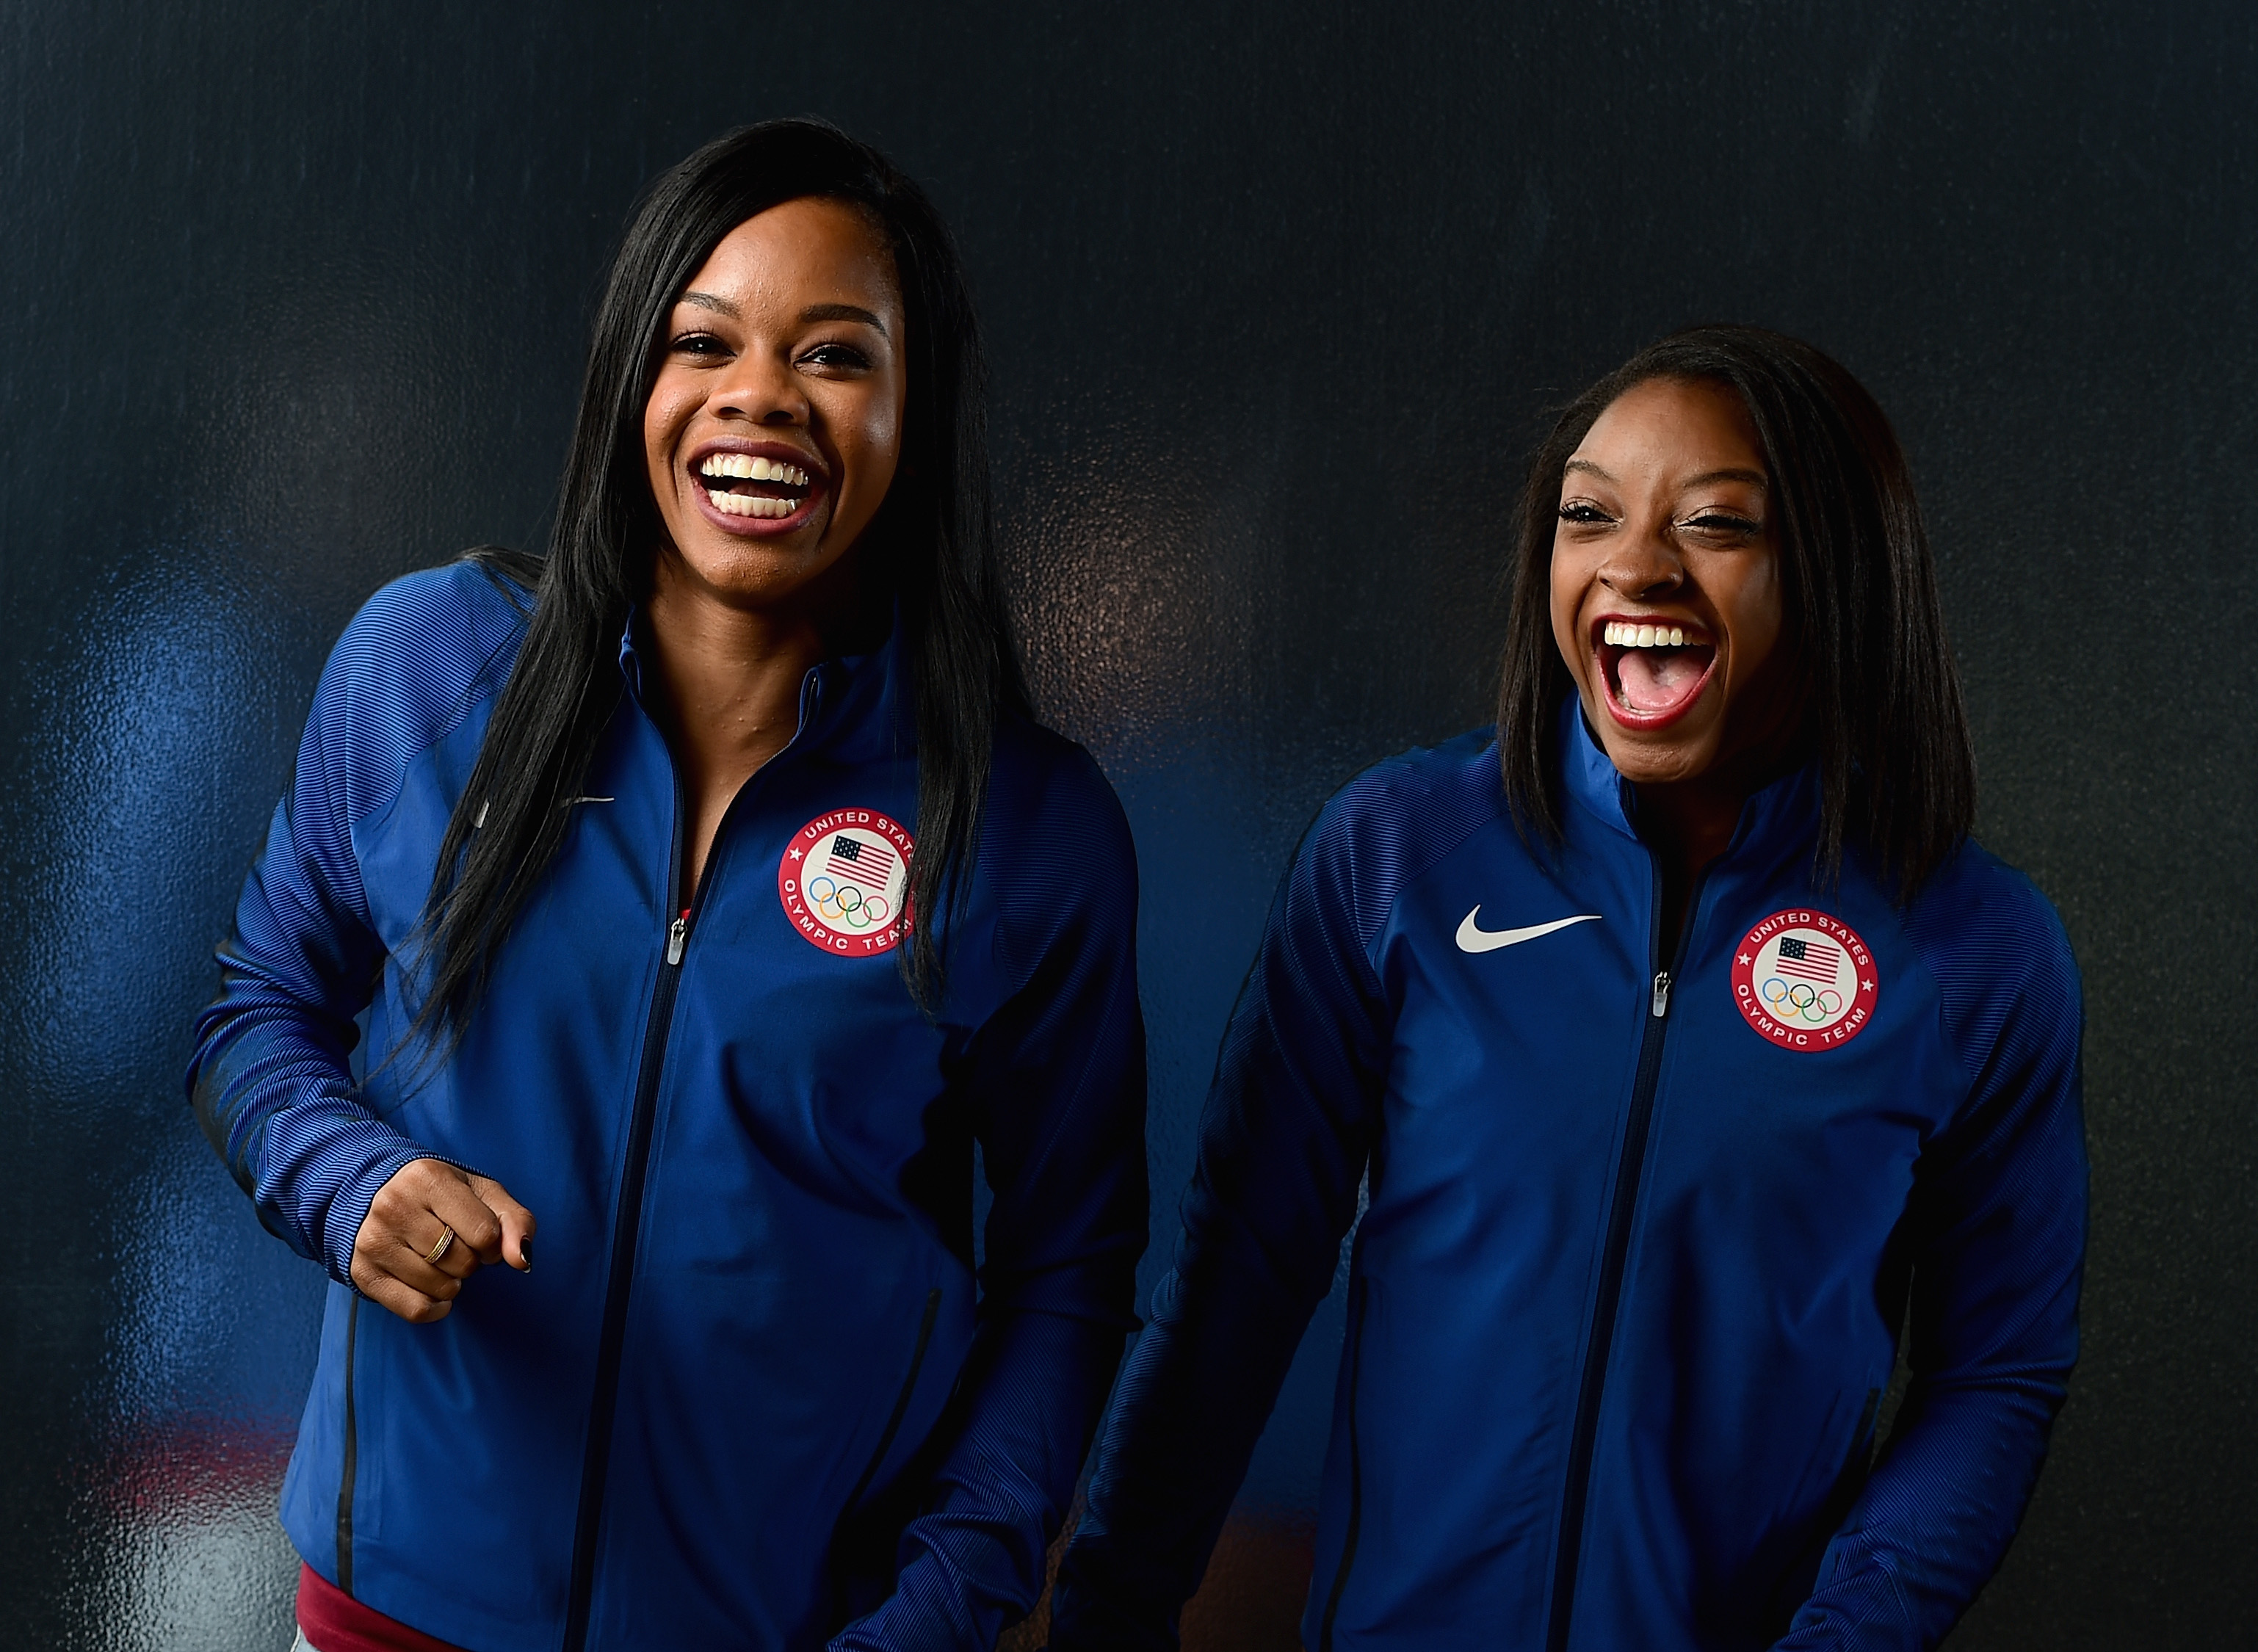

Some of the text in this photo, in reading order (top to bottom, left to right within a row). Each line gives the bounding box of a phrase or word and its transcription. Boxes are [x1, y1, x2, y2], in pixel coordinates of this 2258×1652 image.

[805, 811, 915, 860] UNITED STAT
[784, 879, 848, 949] OLYMPIC
[1750, 913, 1869, 966] UNITED STATES
[1737, 984, 1866, 1045] OLYMPIC TEAM
